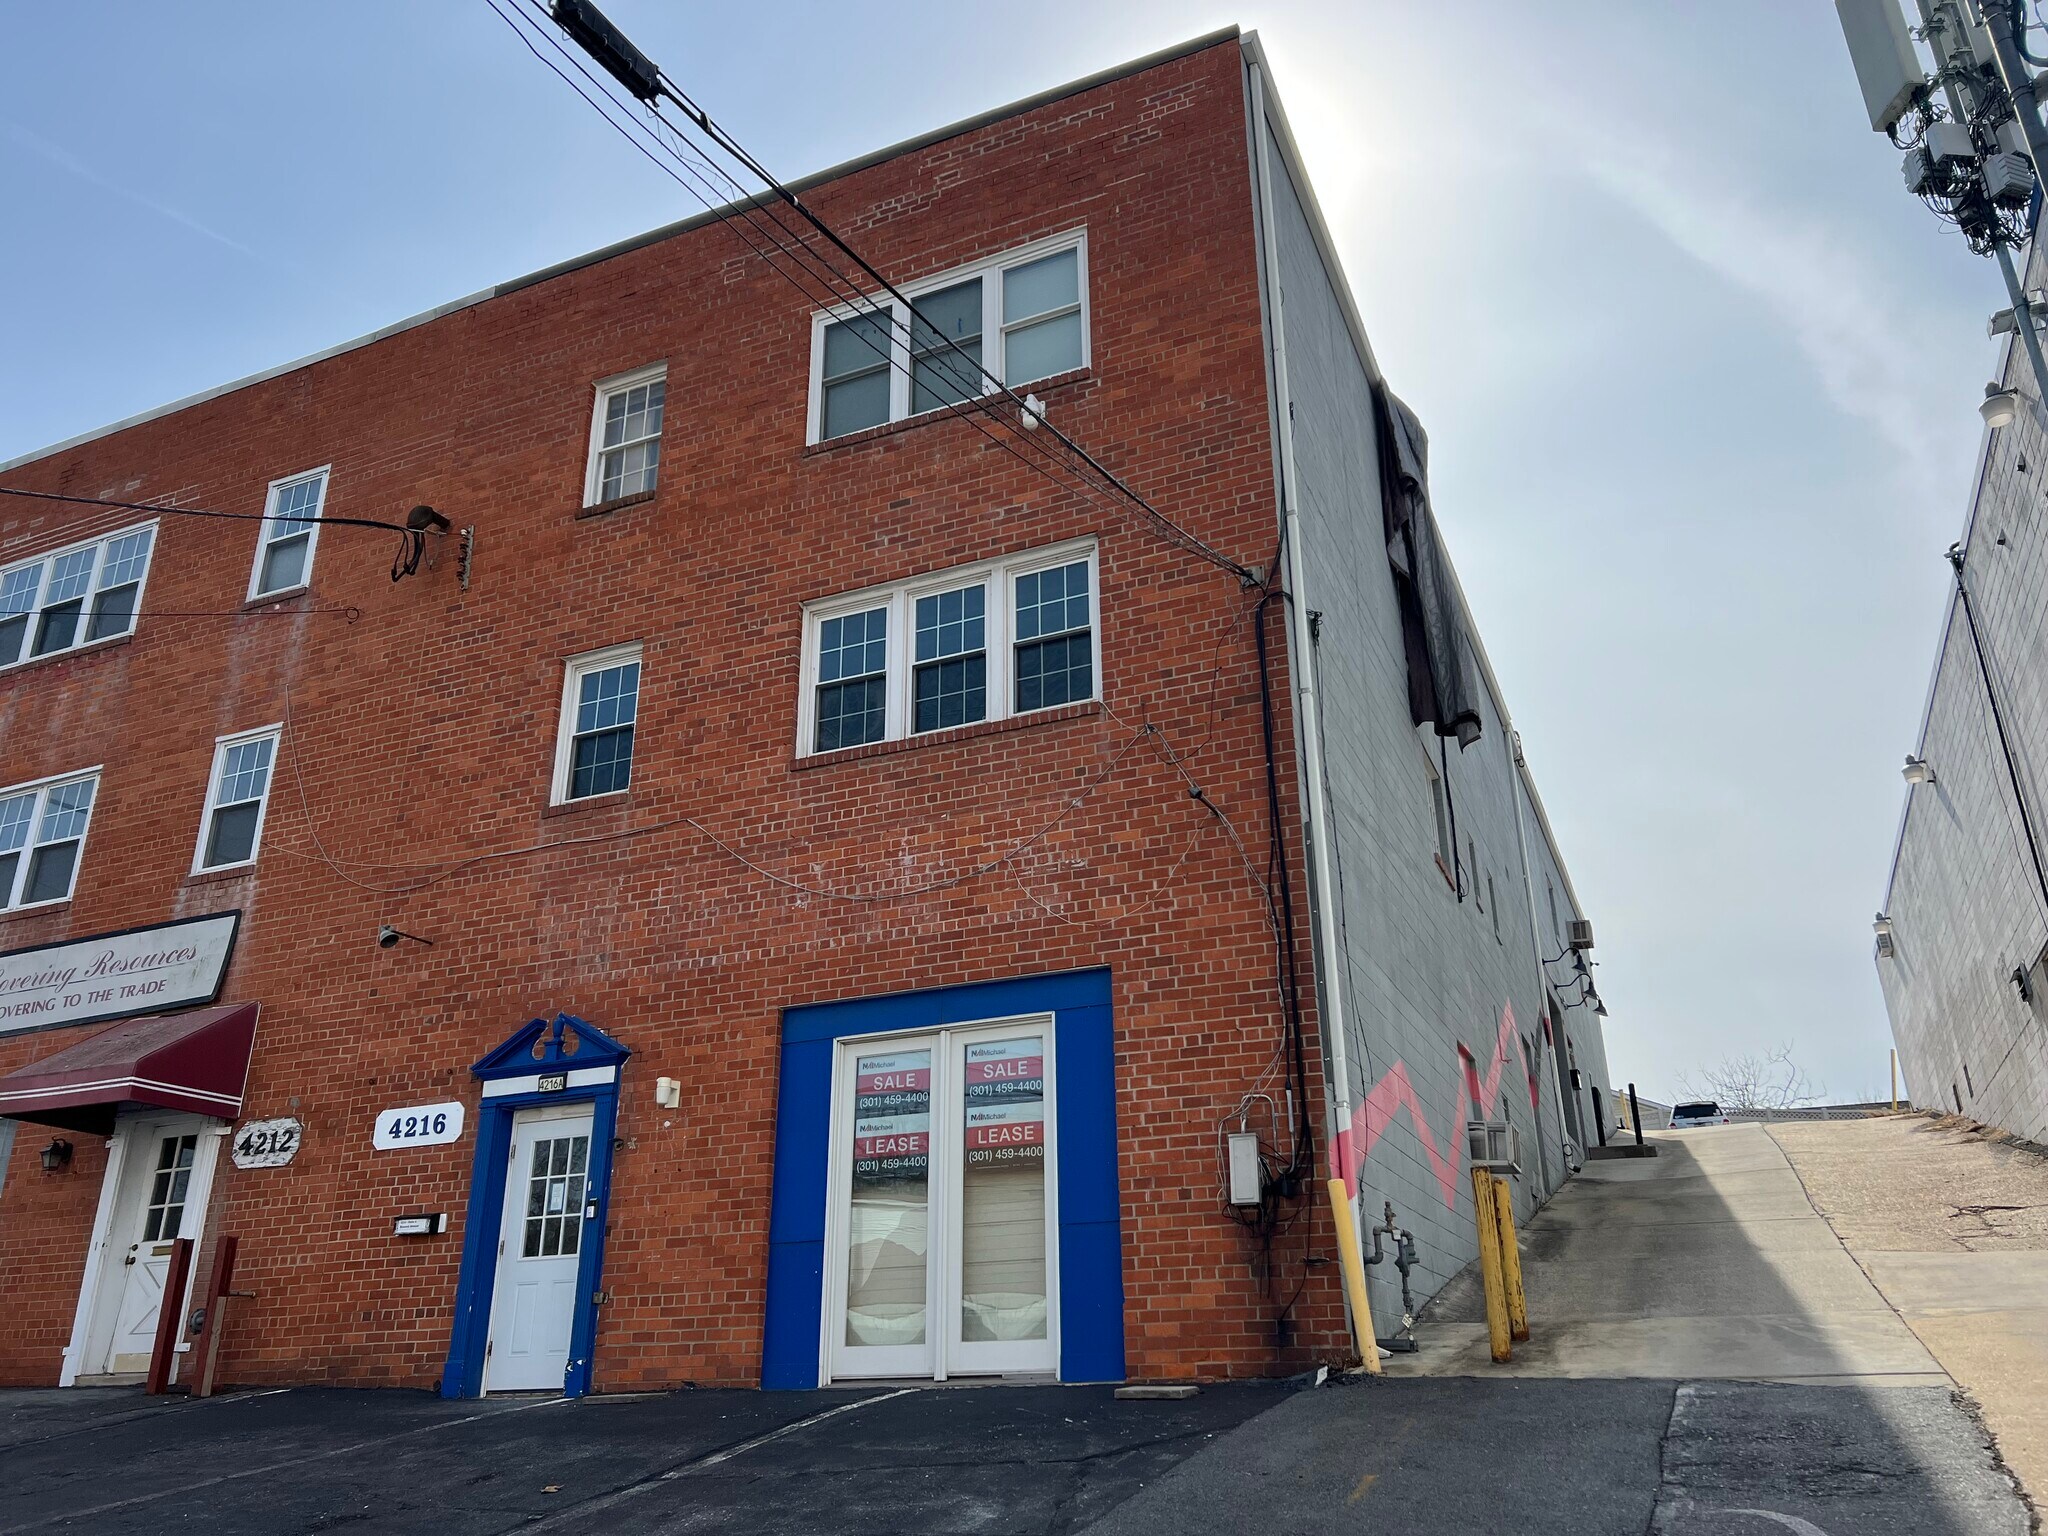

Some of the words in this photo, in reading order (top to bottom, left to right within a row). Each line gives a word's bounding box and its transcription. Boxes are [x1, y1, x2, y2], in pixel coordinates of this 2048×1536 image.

[0, 965, 77, 993] overing
[84, 943, 197, 978] Resources
[63, 993, 81, 1008] TO
[88, 988, 114, 1004] THE
[120, 979, 167, 999] TRADE
[983, 1061, 1028, 1079] SALE
[539, 1077, 564, 1090] 4216A
[873, 1073, 916, 1091] SALE
[969, 1084, 993, 1098] (301)
[995, 1080, 1042, 1094] 459-4400
[859, 1096, 882, 1110] (301)
[884, 1091, 929, 1106] 459-4400
[389, 1113, 447, 1139] 4216
[977, 1125, 1035, 1144] LEASE
[238, 1130, 294, 1156] 4212
[865, 1136, 919, 1155] LEASE
[856, 1159, 879, 1172] (301)
[881, 1156, 927, 1170] 459-4400
[968, 1150, 993, 1163] (301)
[995, 1146, 1043, 1160] 459-4400
